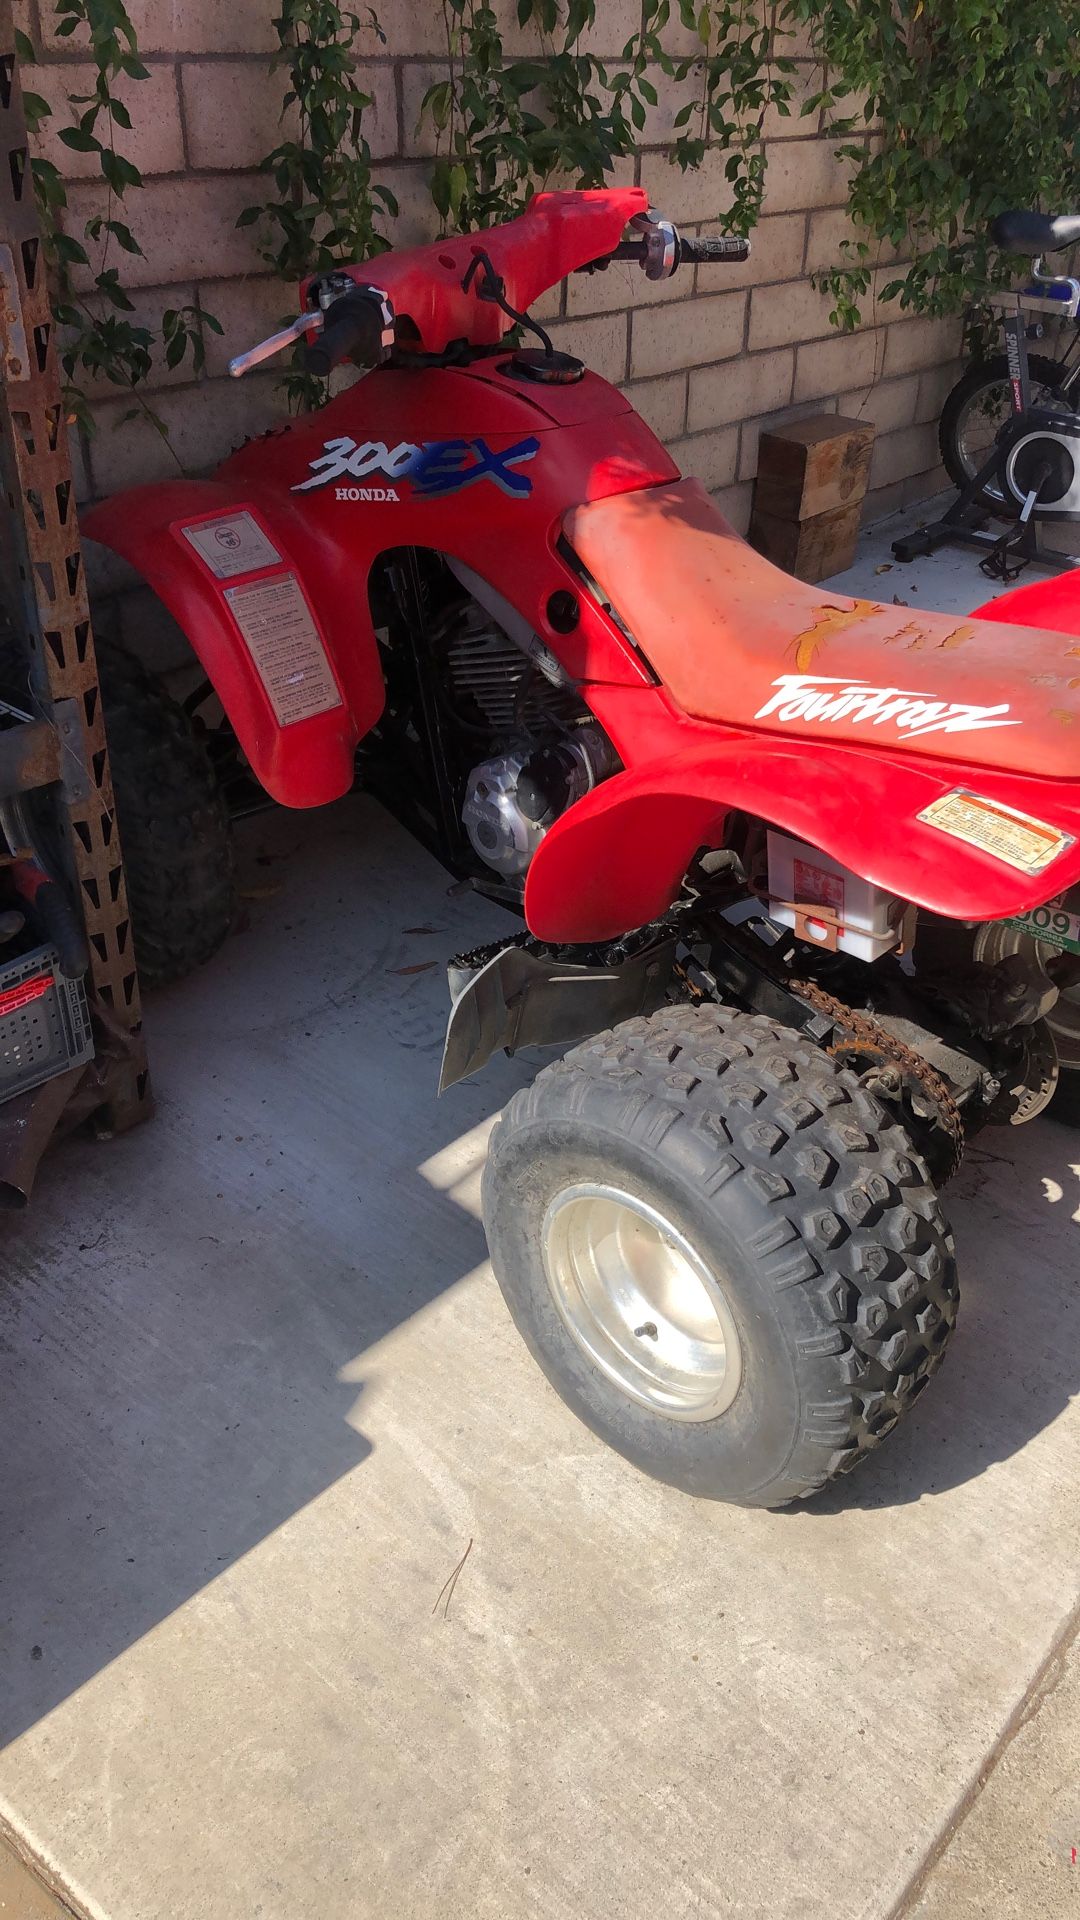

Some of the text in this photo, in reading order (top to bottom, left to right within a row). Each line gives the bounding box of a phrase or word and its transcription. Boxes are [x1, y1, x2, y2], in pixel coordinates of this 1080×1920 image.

[1005, 332, 1021, 411] SPINNER SPORT
[335, 487, 401, 502] HONDA
[1012, 920, 1065, 943] CALIFORNIA
